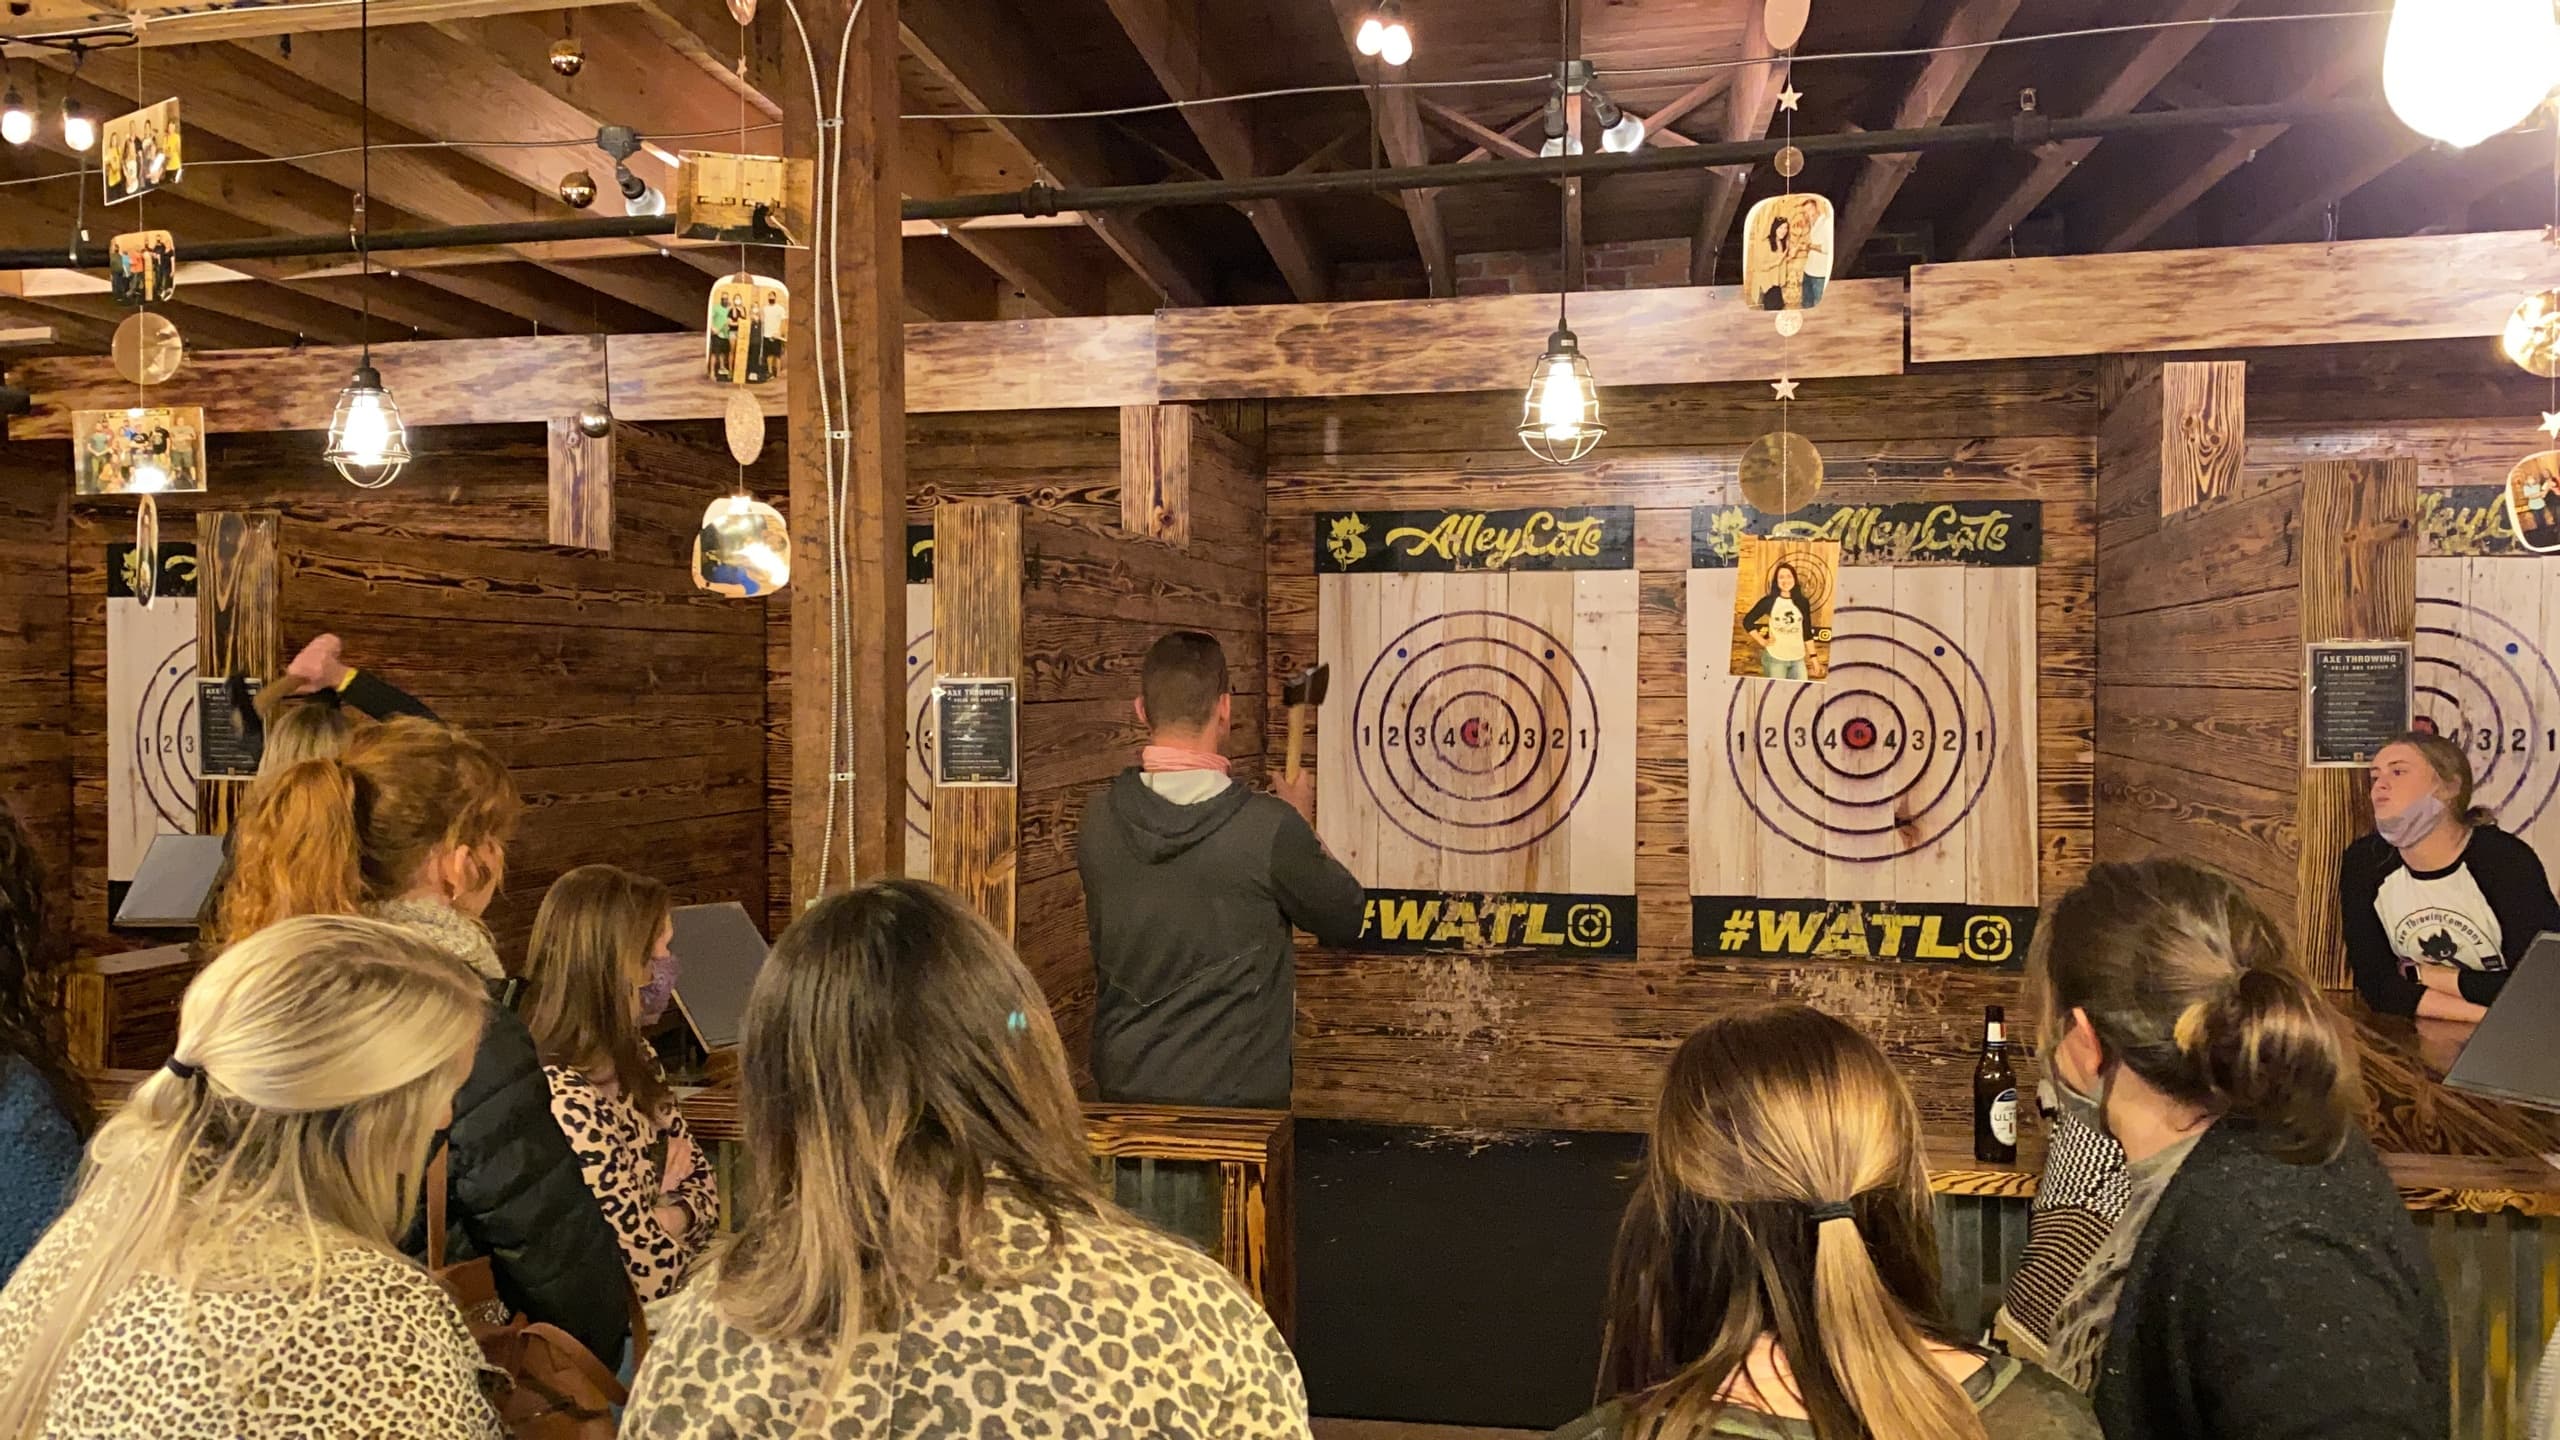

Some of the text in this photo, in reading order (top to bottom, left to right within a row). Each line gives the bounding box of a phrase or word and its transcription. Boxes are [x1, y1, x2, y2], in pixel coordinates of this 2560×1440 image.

[2322, 654, 2397, 663] AXE THROWING
[143, 735, 194, 754] 1 2 3
[1362, 725, 1371, 746] 1
[1387, 726, 1400, 746] 2
[1414, 726, 1426, 746] 3
[1443, 727, 1456, 747] 4
[1523, 728, 1536, 748] 3
[1551, 728, 1565, 749] 2
[1579, 729, 1588, 749] 1
[1737, 727, 1983, 752] 1 2 3 4 4 3 2 1
[2477, 728, 2492, 750] 3
[2511, 728, 2526, 751] 2
[2546, 729, 2556, 751] 1
[1719, 909, 1962, 958] #WATL
[2443, 913, 2483, 946] Company
